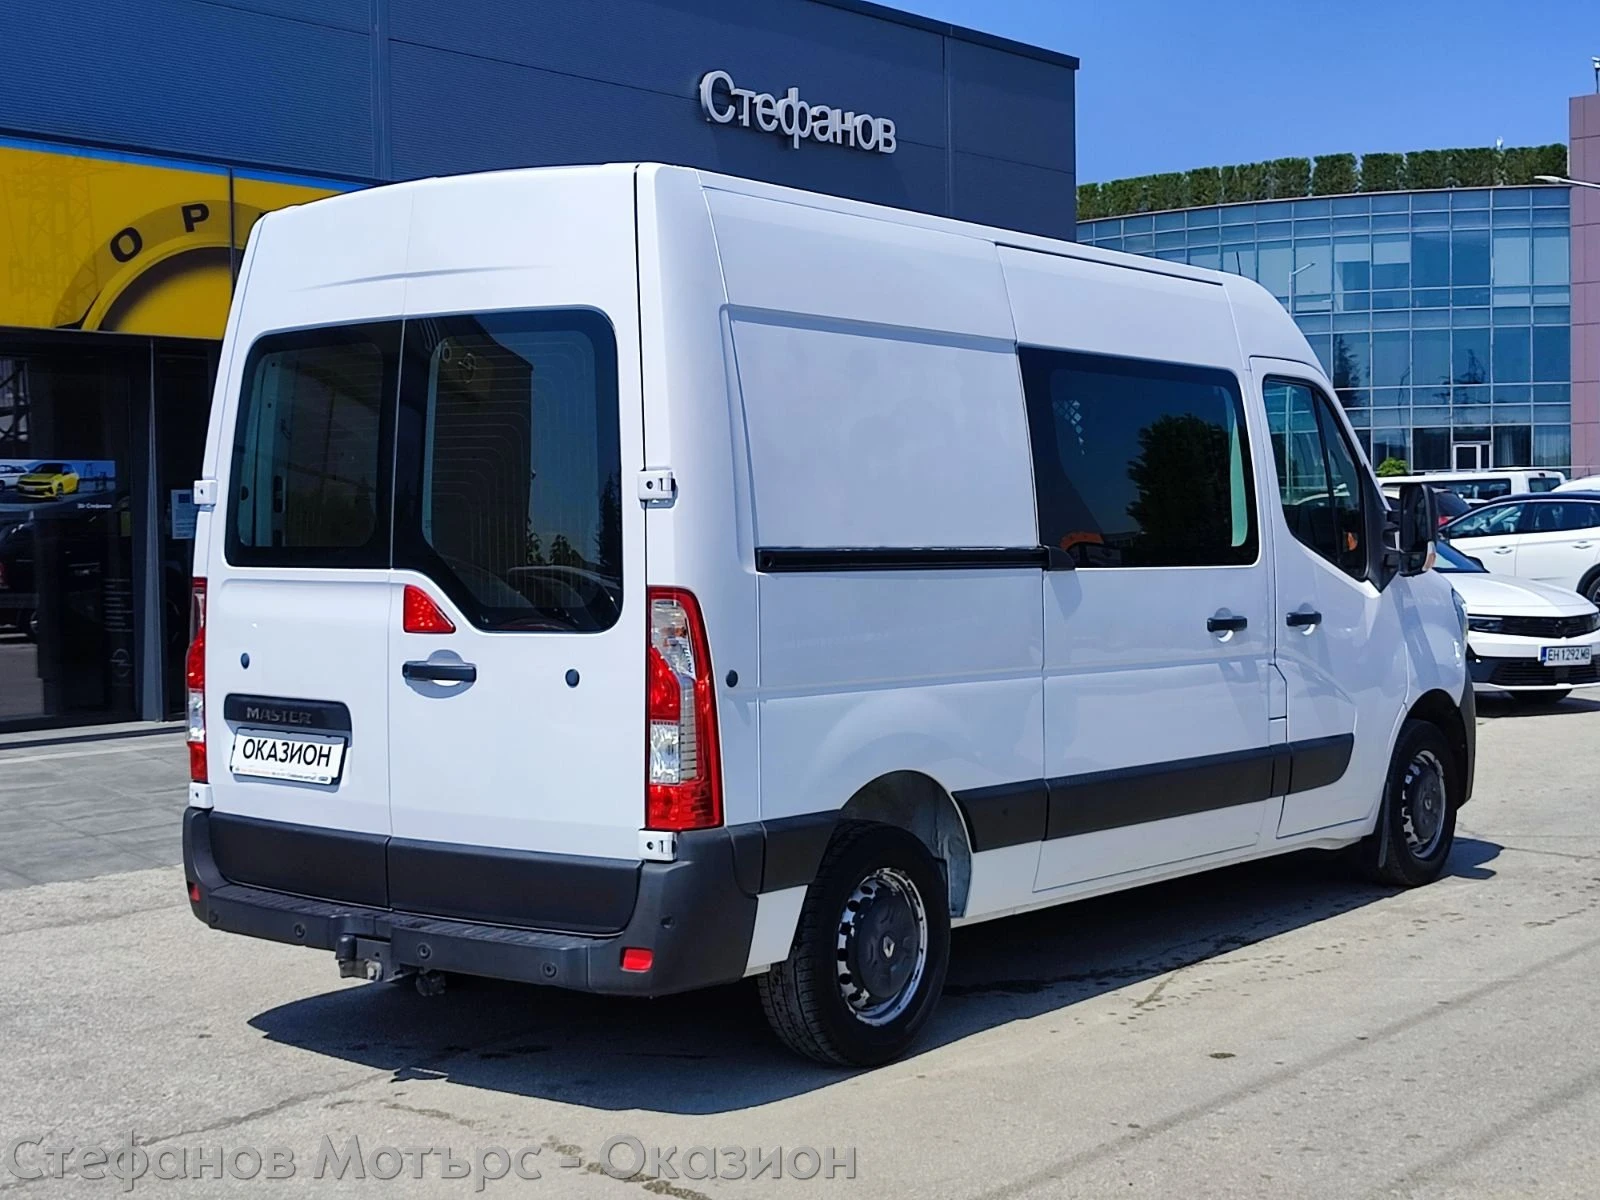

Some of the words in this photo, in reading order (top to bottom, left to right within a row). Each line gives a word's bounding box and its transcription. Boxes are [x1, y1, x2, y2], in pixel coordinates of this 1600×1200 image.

[699, 70, 897, 154] Стефанов
[110, 203, 267, 263] OP
[246, 706, 312, 724] MASTER
[243, 738, 332, 767] ОКАЗИОН
